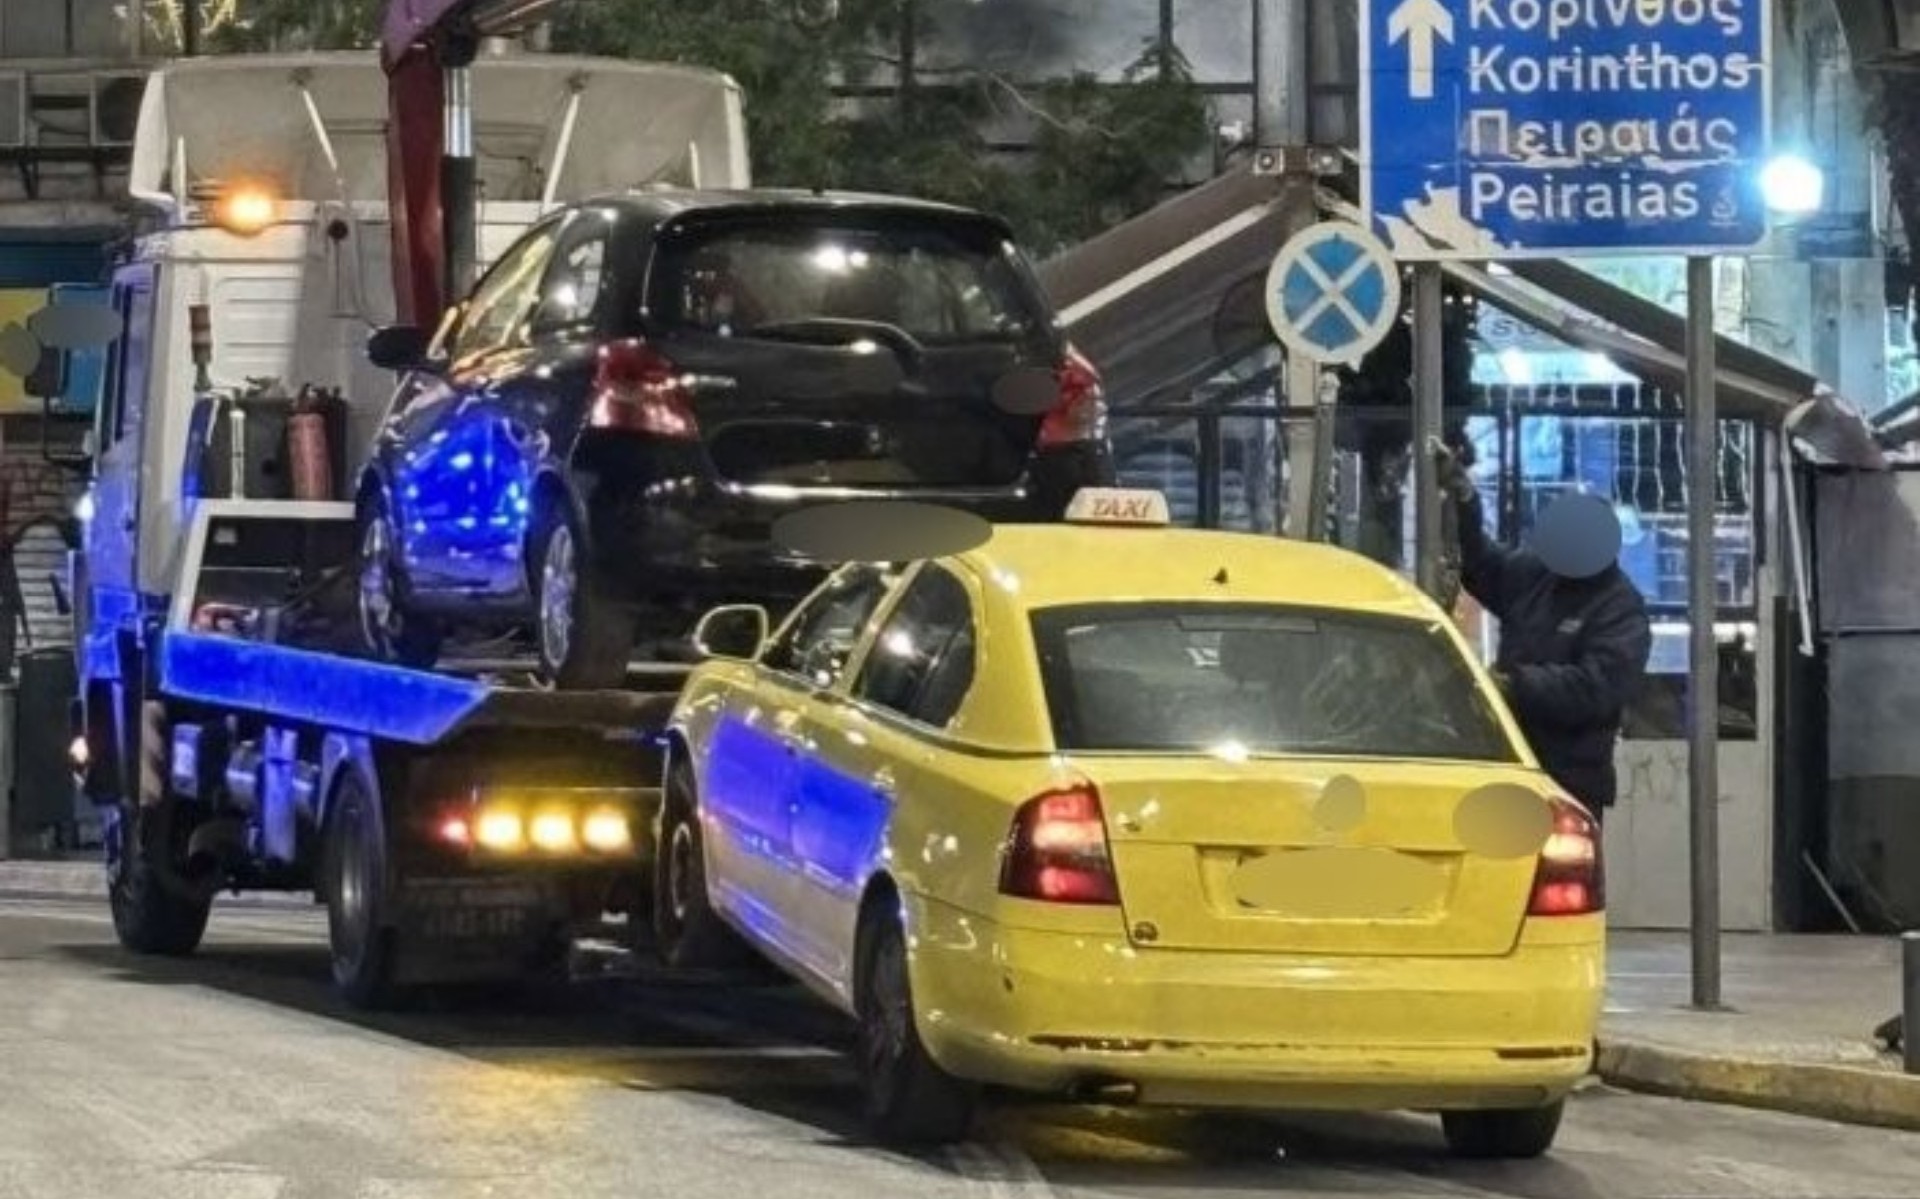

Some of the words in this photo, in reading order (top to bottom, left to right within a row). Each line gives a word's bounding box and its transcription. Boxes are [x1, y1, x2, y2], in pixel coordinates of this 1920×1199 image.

[1469, 41, 1750, 92] Korinthos
[1469, 102, 1737, 159] Πειραιάς
[1470, 172, 1700, 220] Peiraias
[1093, 498, 1151, 518] TAXI
